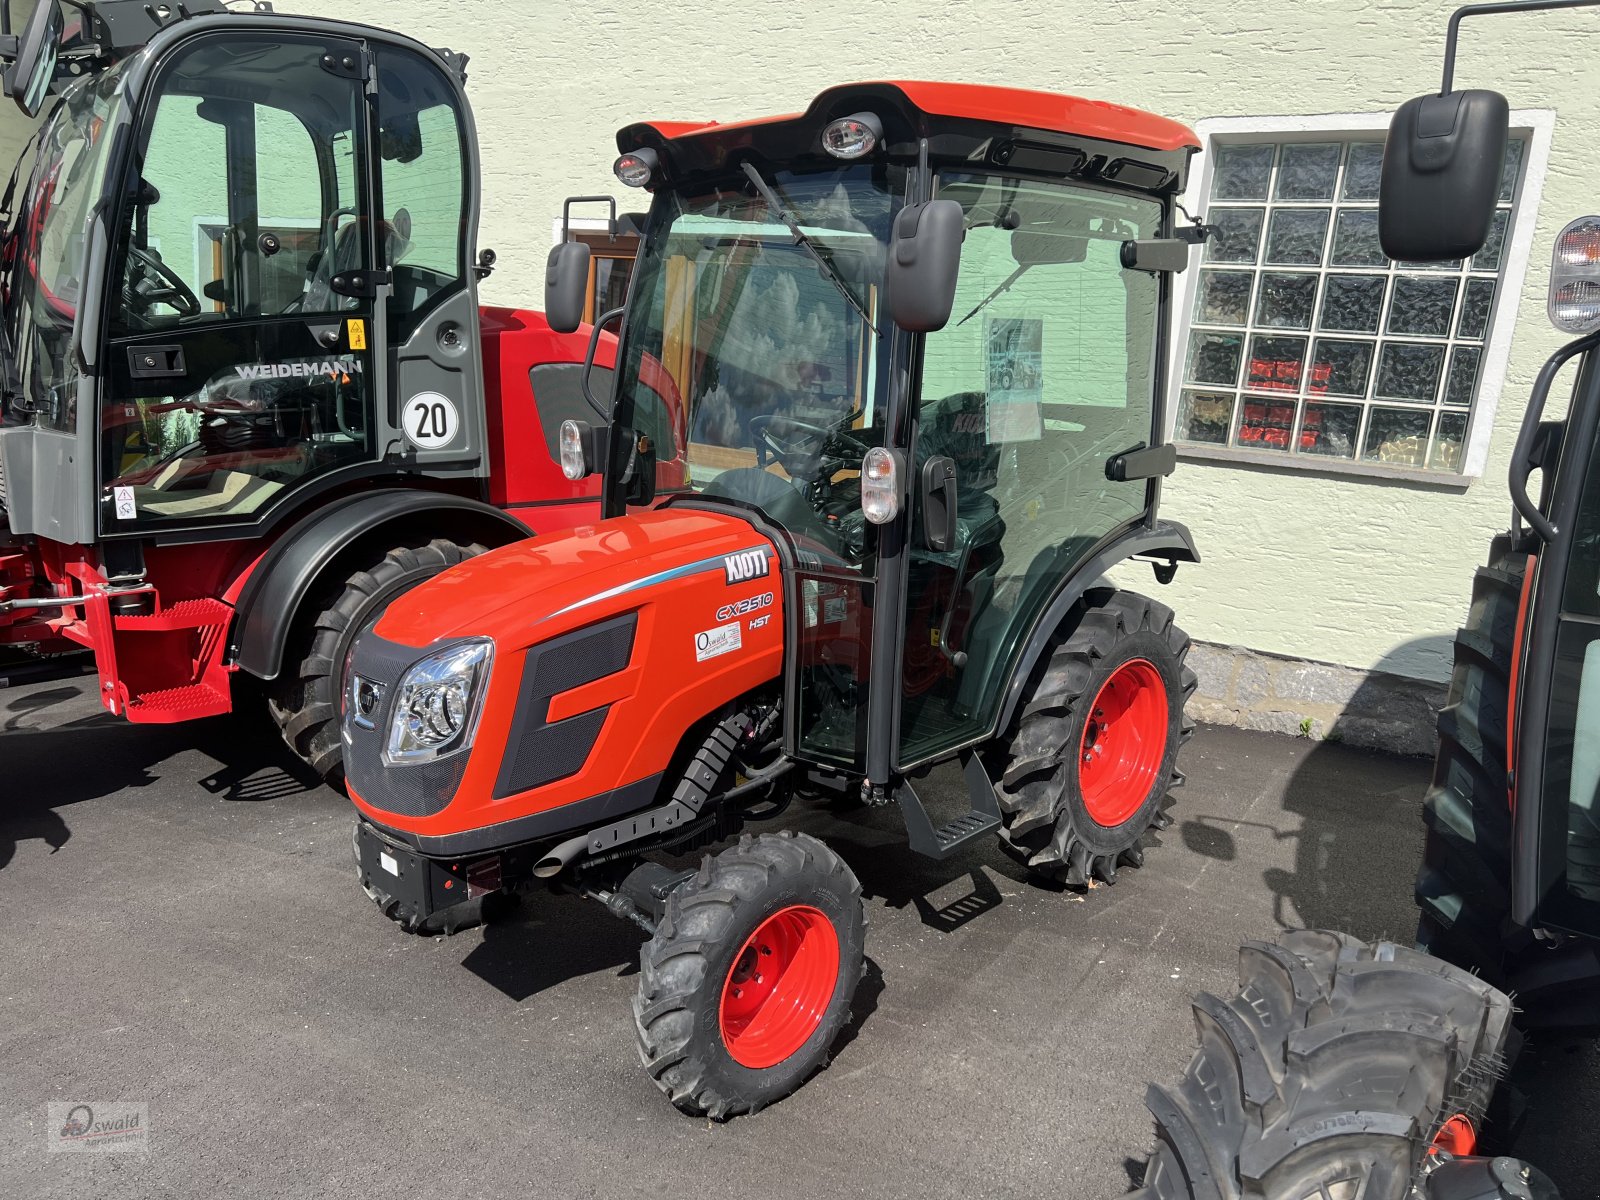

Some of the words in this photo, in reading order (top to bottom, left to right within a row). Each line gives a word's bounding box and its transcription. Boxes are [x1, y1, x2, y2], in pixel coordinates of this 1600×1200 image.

[235, 360, 362, 380] WEIDEMANN
[414, 402, 447, 438] 20
[724, 549, 768, 582] KIOTI
[716, 592, 774, 621] CX2510
[748, 614, 771, 631] HST
[697, 632, 726, 651] Oswald
